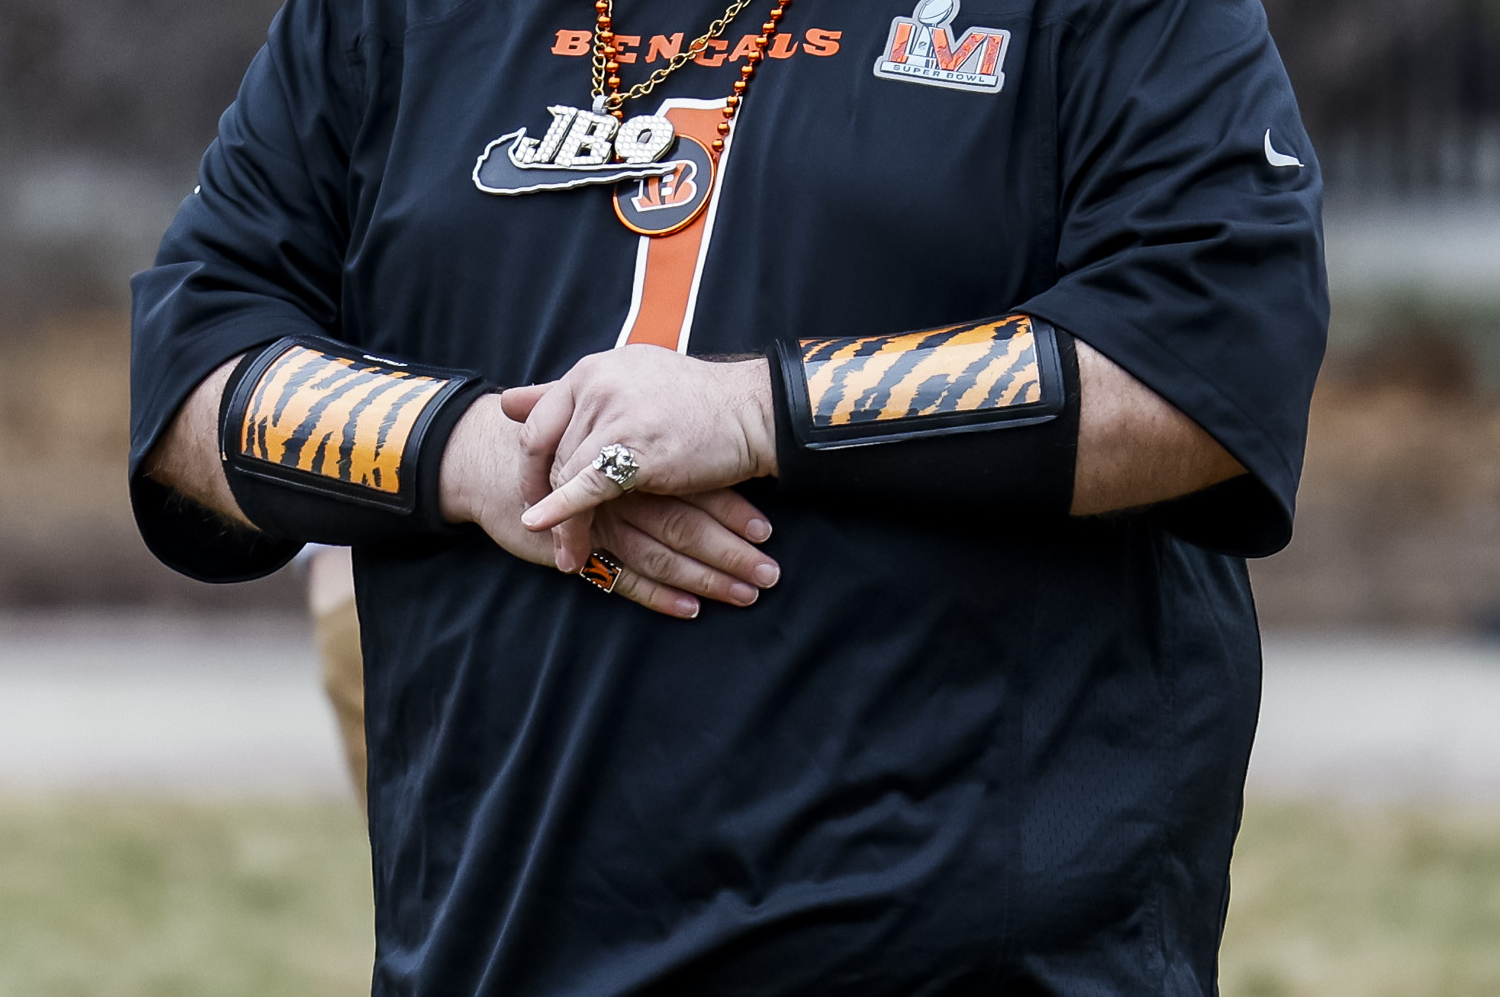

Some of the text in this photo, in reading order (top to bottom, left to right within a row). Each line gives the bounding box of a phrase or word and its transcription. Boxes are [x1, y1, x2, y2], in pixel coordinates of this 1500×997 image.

[550, 27, 843, 67] BENGALS
[889, 22, 1004, 76] LVI
[892, 64, 985, 83] SUPER BOWL
